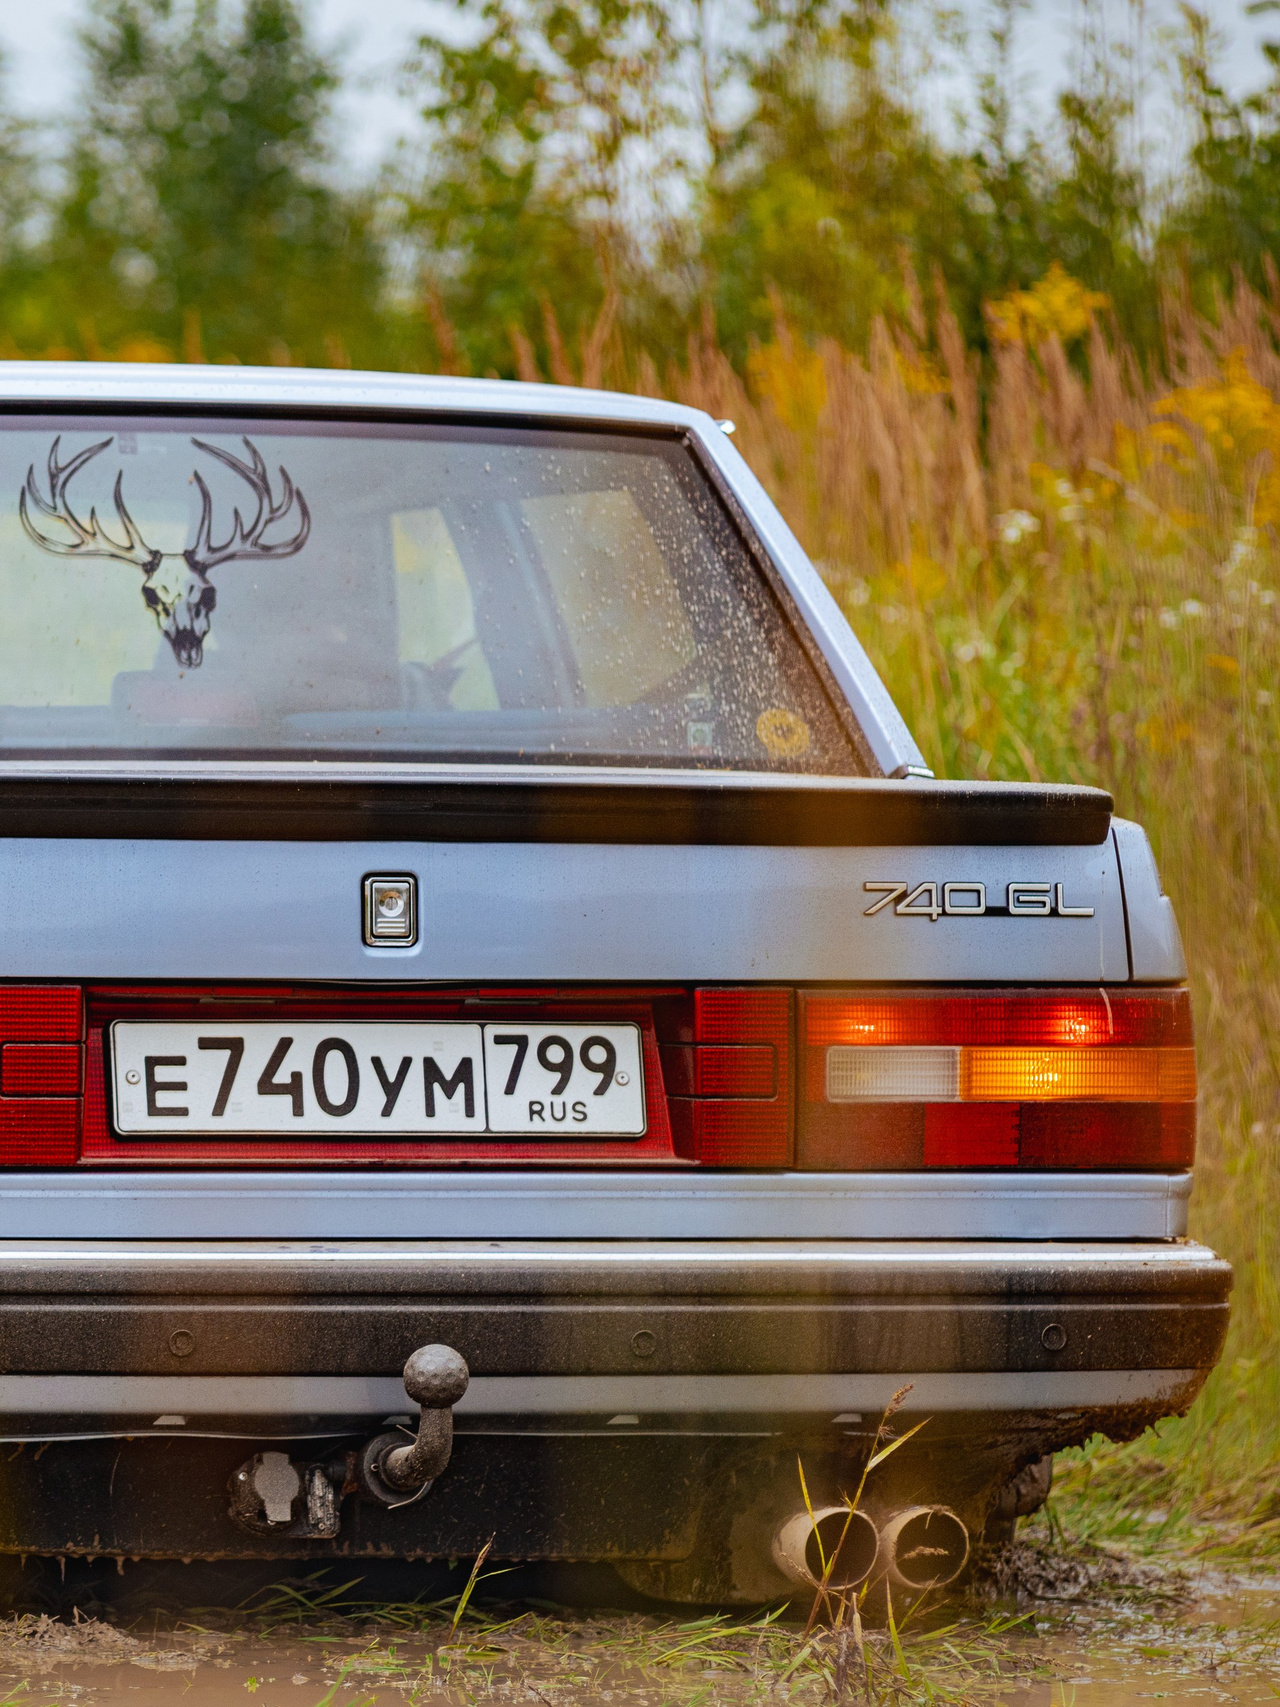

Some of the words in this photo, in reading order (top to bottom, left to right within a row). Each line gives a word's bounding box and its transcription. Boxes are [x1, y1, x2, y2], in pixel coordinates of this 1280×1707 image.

[864, 881, 986, 921] 740
[1008, 882, 1095, 916] GL
[493, 1034, 617, 1097] 799
[528, 1100, 588, 1123] RUS
